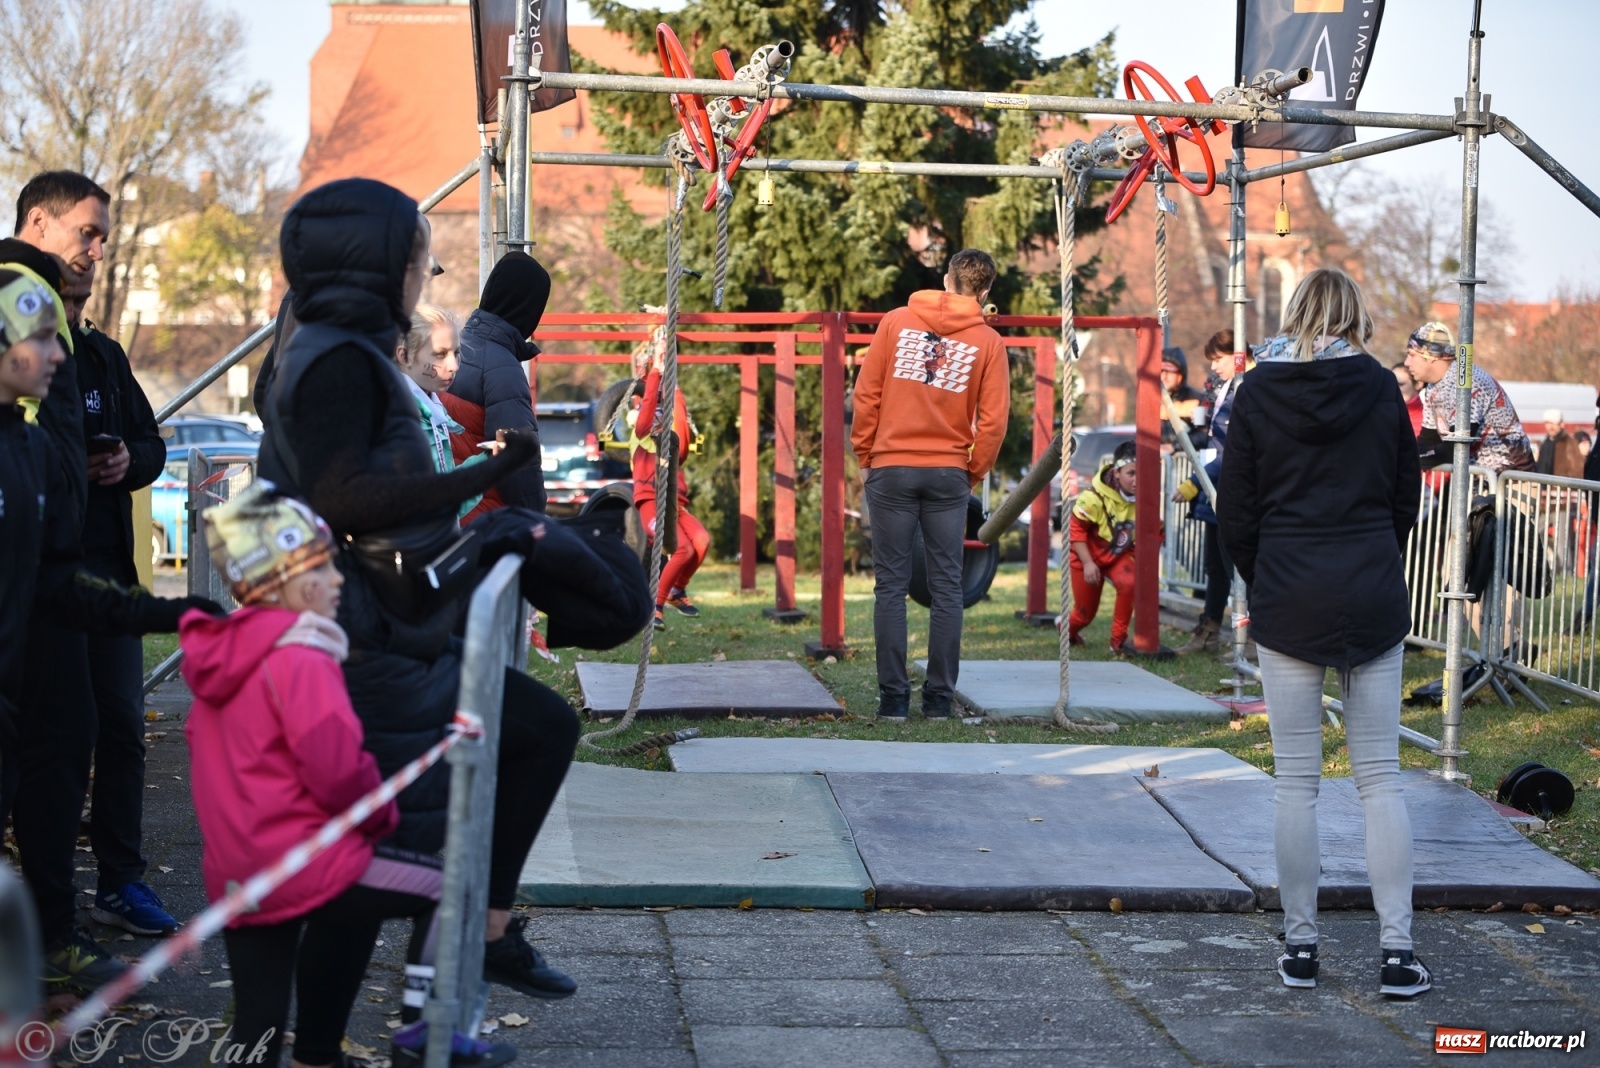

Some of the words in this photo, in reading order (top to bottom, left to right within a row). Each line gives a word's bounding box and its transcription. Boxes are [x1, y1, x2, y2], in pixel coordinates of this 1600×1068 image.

[1345, 25, 1370, 101] DRZWI
[422, 362, 442, 379] 25
[893, 369, 968, 393] GOKU
